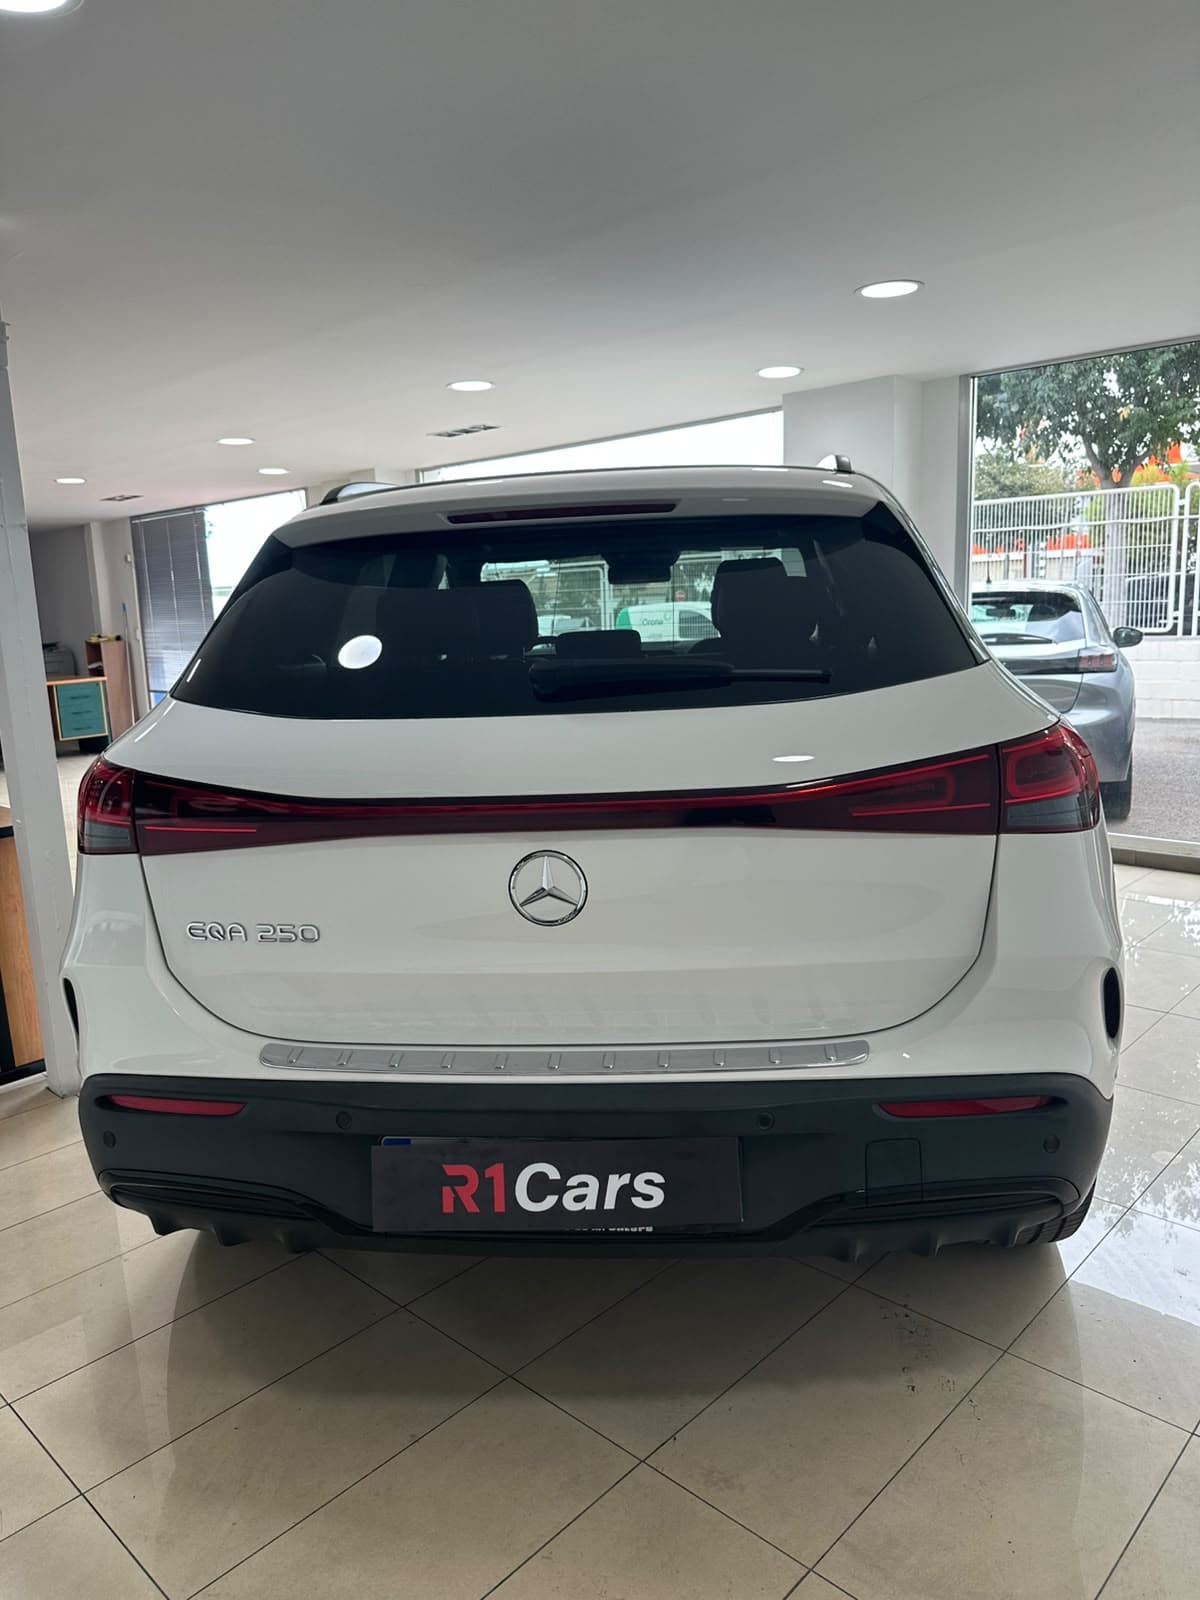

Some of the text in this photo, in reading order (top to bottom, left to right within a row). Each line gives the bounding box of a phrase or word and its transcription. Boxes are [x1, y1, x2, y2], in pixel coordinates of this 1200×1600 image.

[186, 921, 320, 943] EQA 250
[441, 1162, 666, 1213] R1Cars
